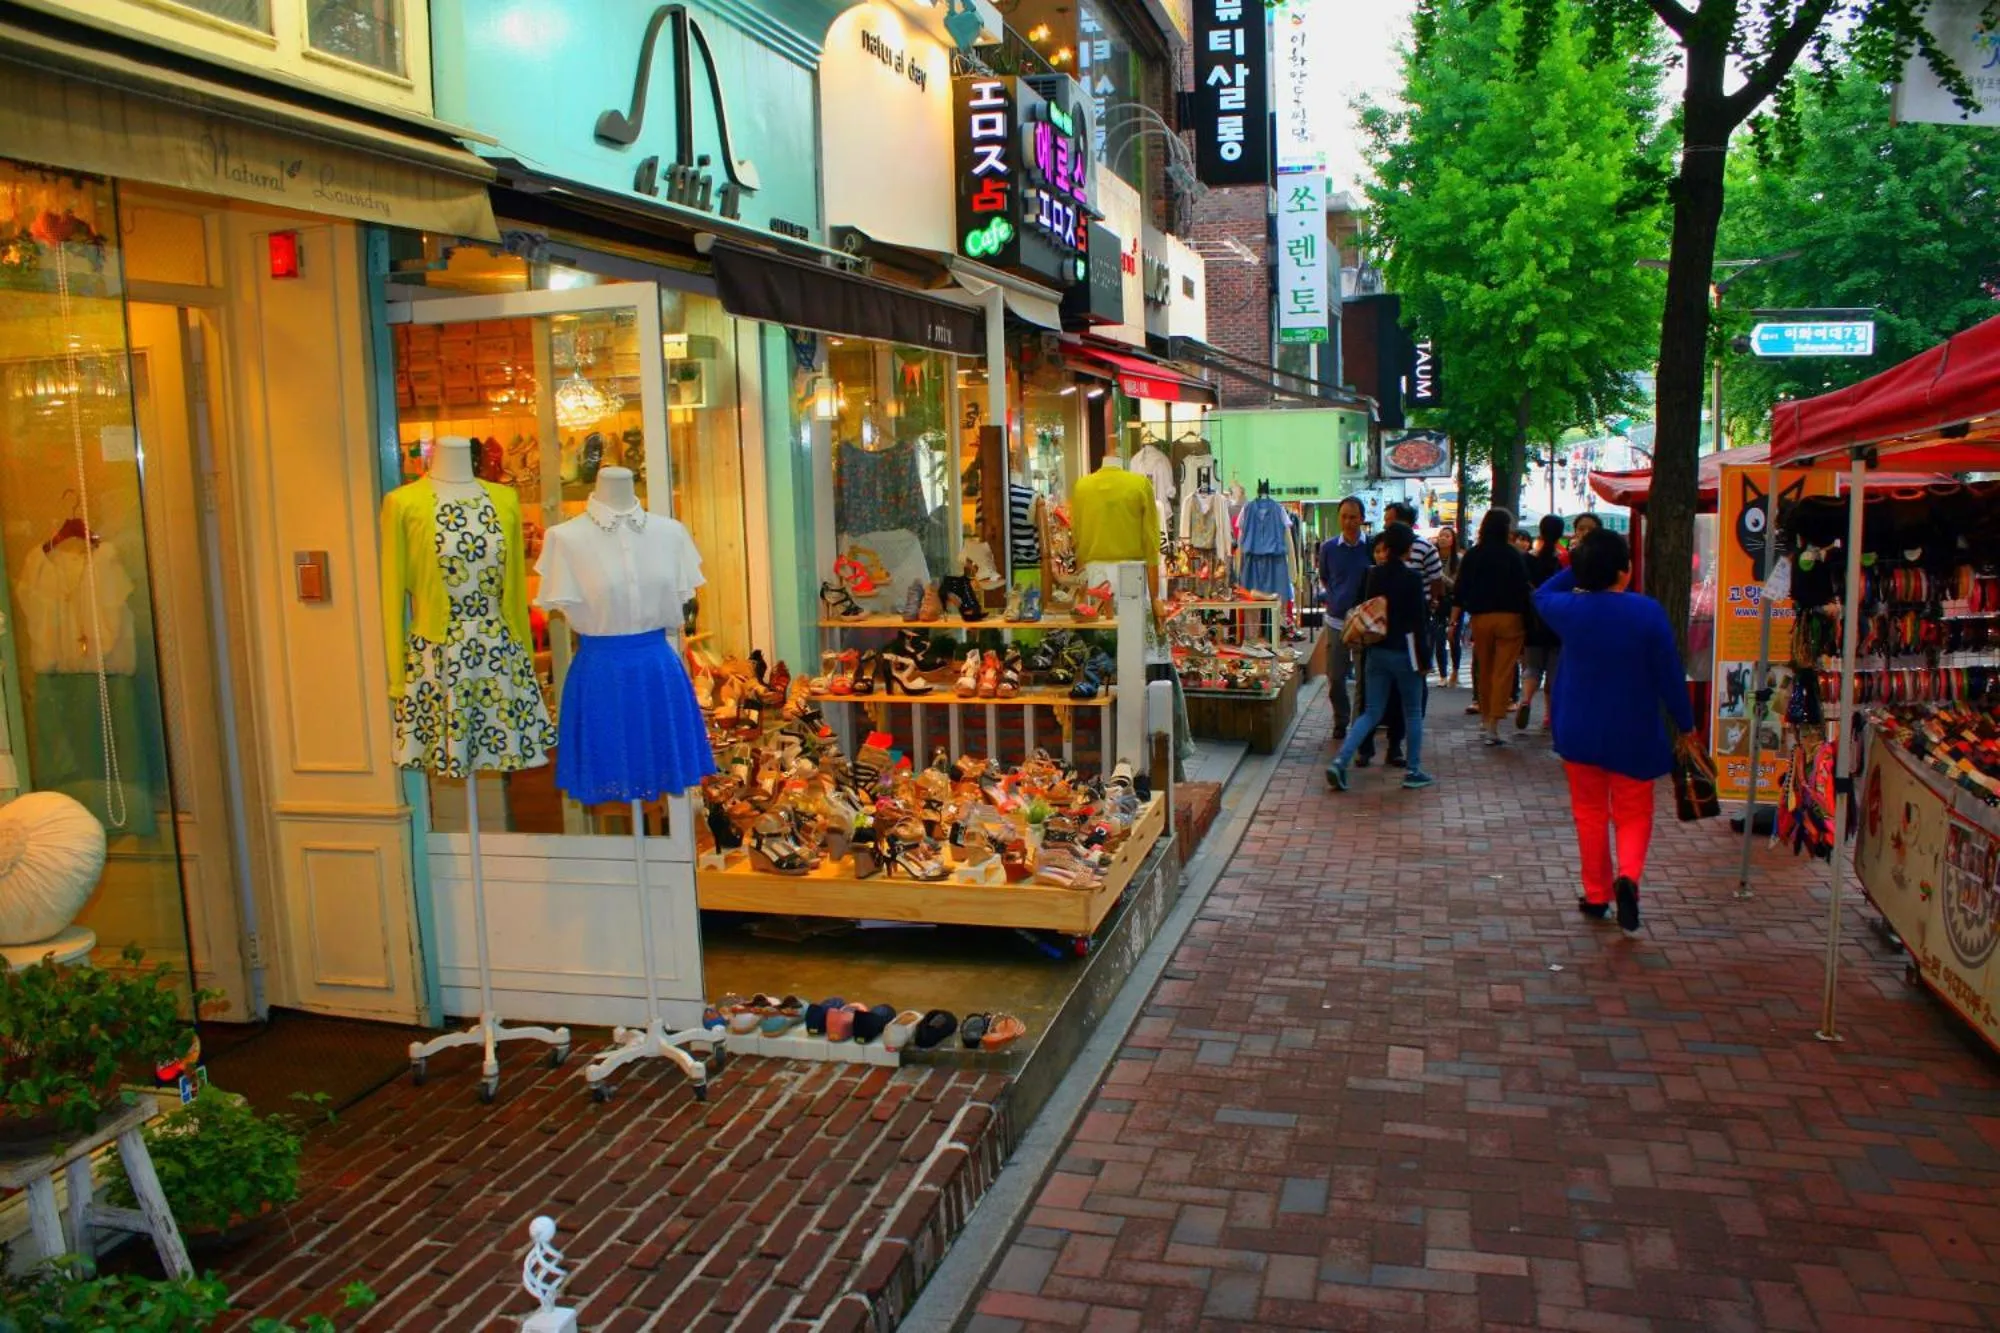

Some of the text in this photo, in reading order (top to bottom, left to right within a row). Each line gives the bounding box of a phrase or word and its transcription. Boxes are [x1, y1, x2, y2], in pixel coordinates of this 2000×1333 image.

[861, 29, 927, 93] natural day
[200, 133, 392, 218] Natural Laundry
[1035, 121, 1088, 204] 에로스
[965, 216, 1013, 257] Cafe
[1415, 335, 1433, 398] TAUM
